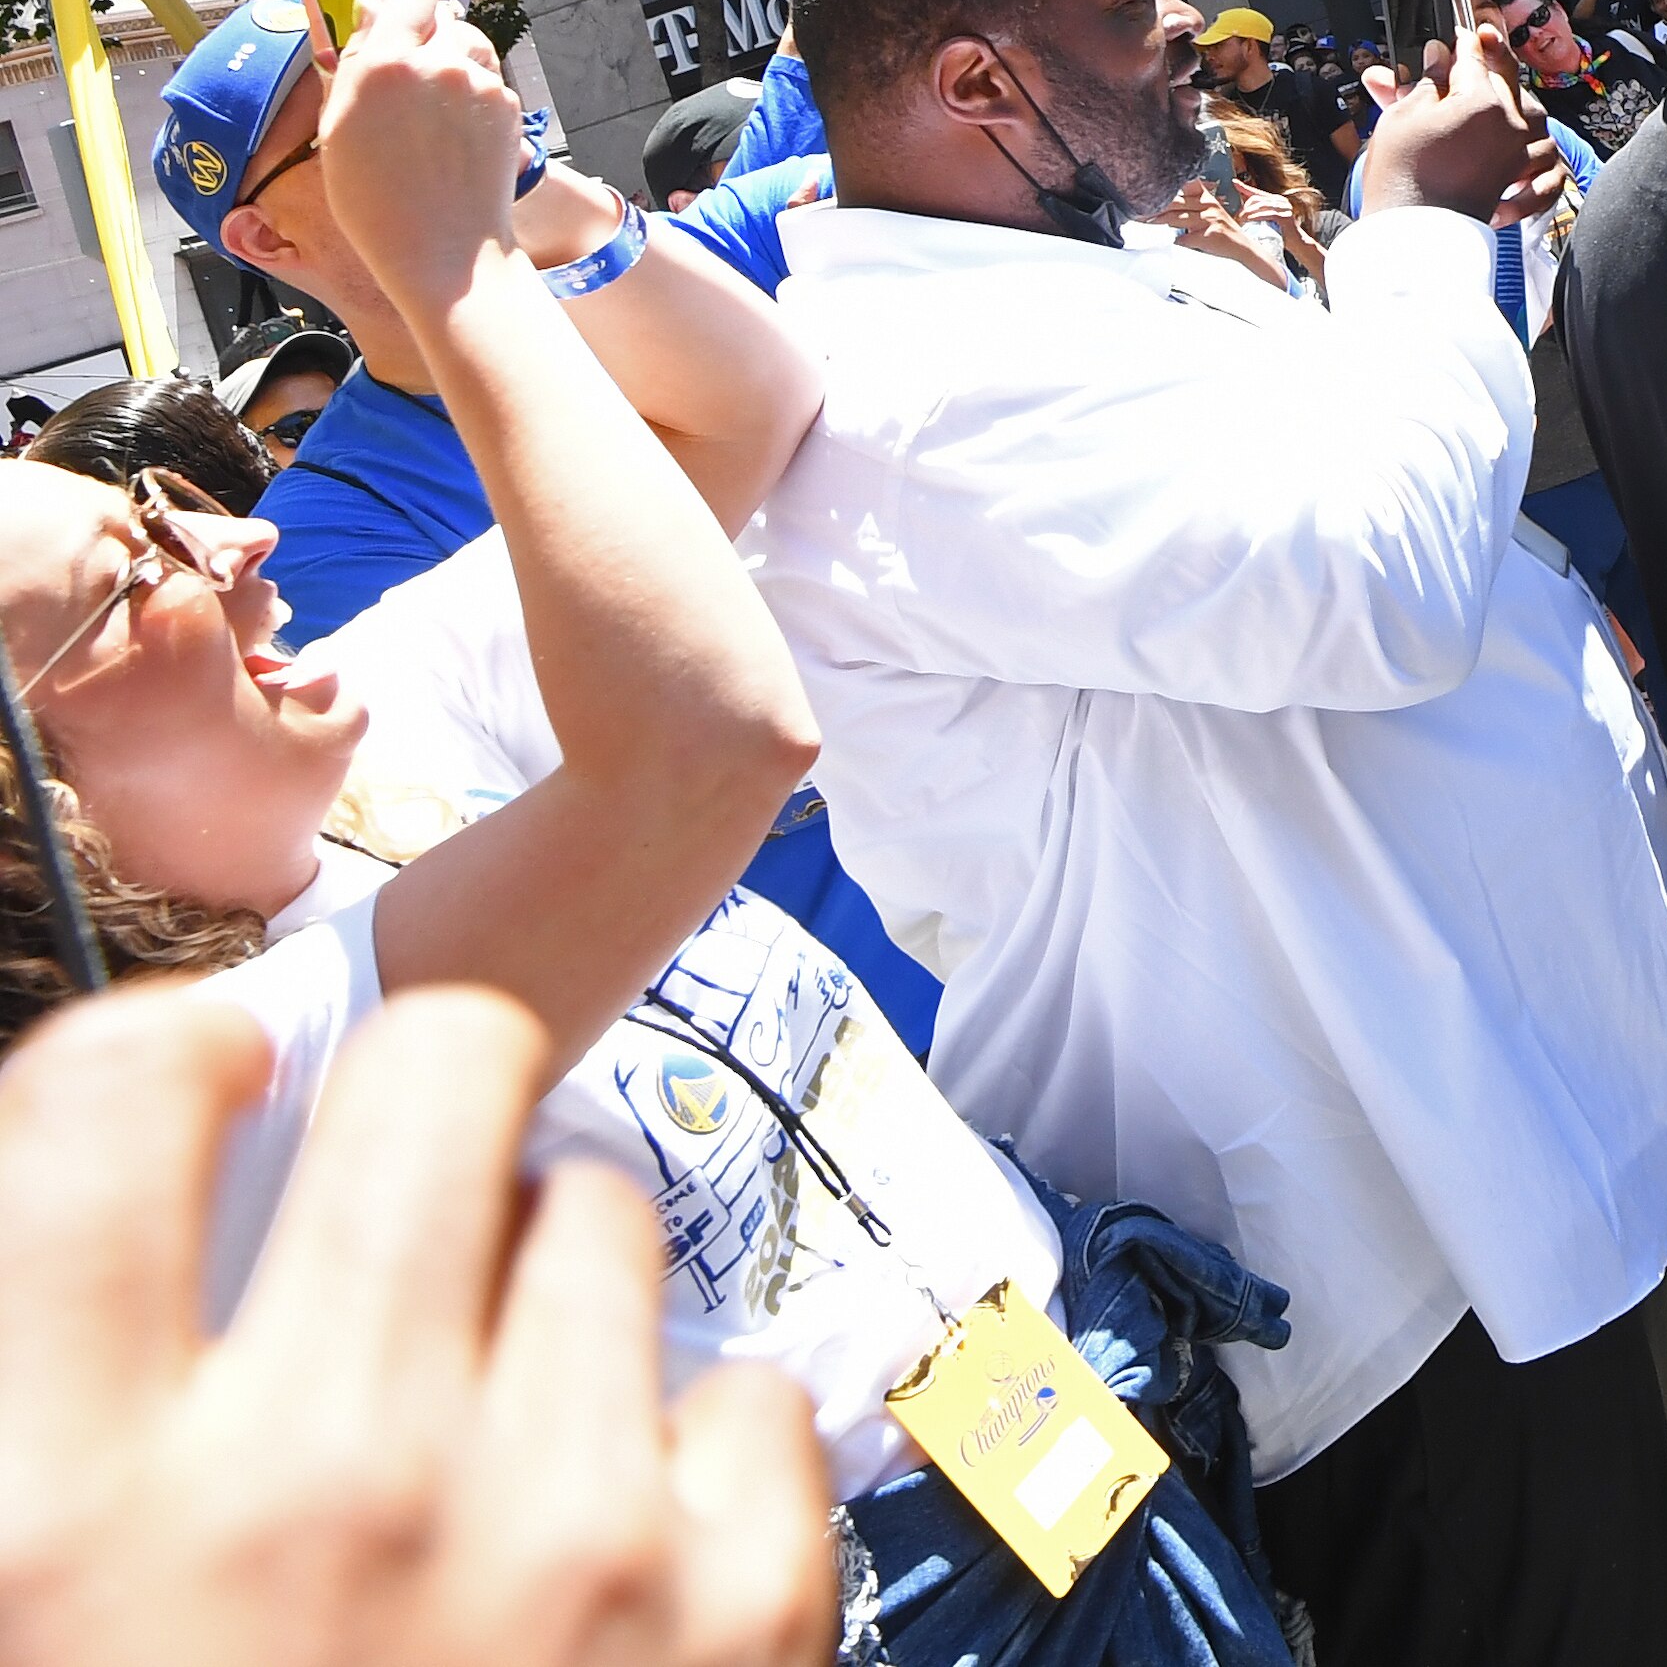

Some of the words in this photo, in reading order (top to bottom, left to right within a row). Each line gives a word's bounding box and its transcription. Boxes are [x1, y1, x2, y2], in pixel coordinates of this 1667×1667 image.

[663, 1215, 684, 1234] TO
[663, 1208, 714, 1271] SF
[958, 1351, 1057, 1471] Champions
